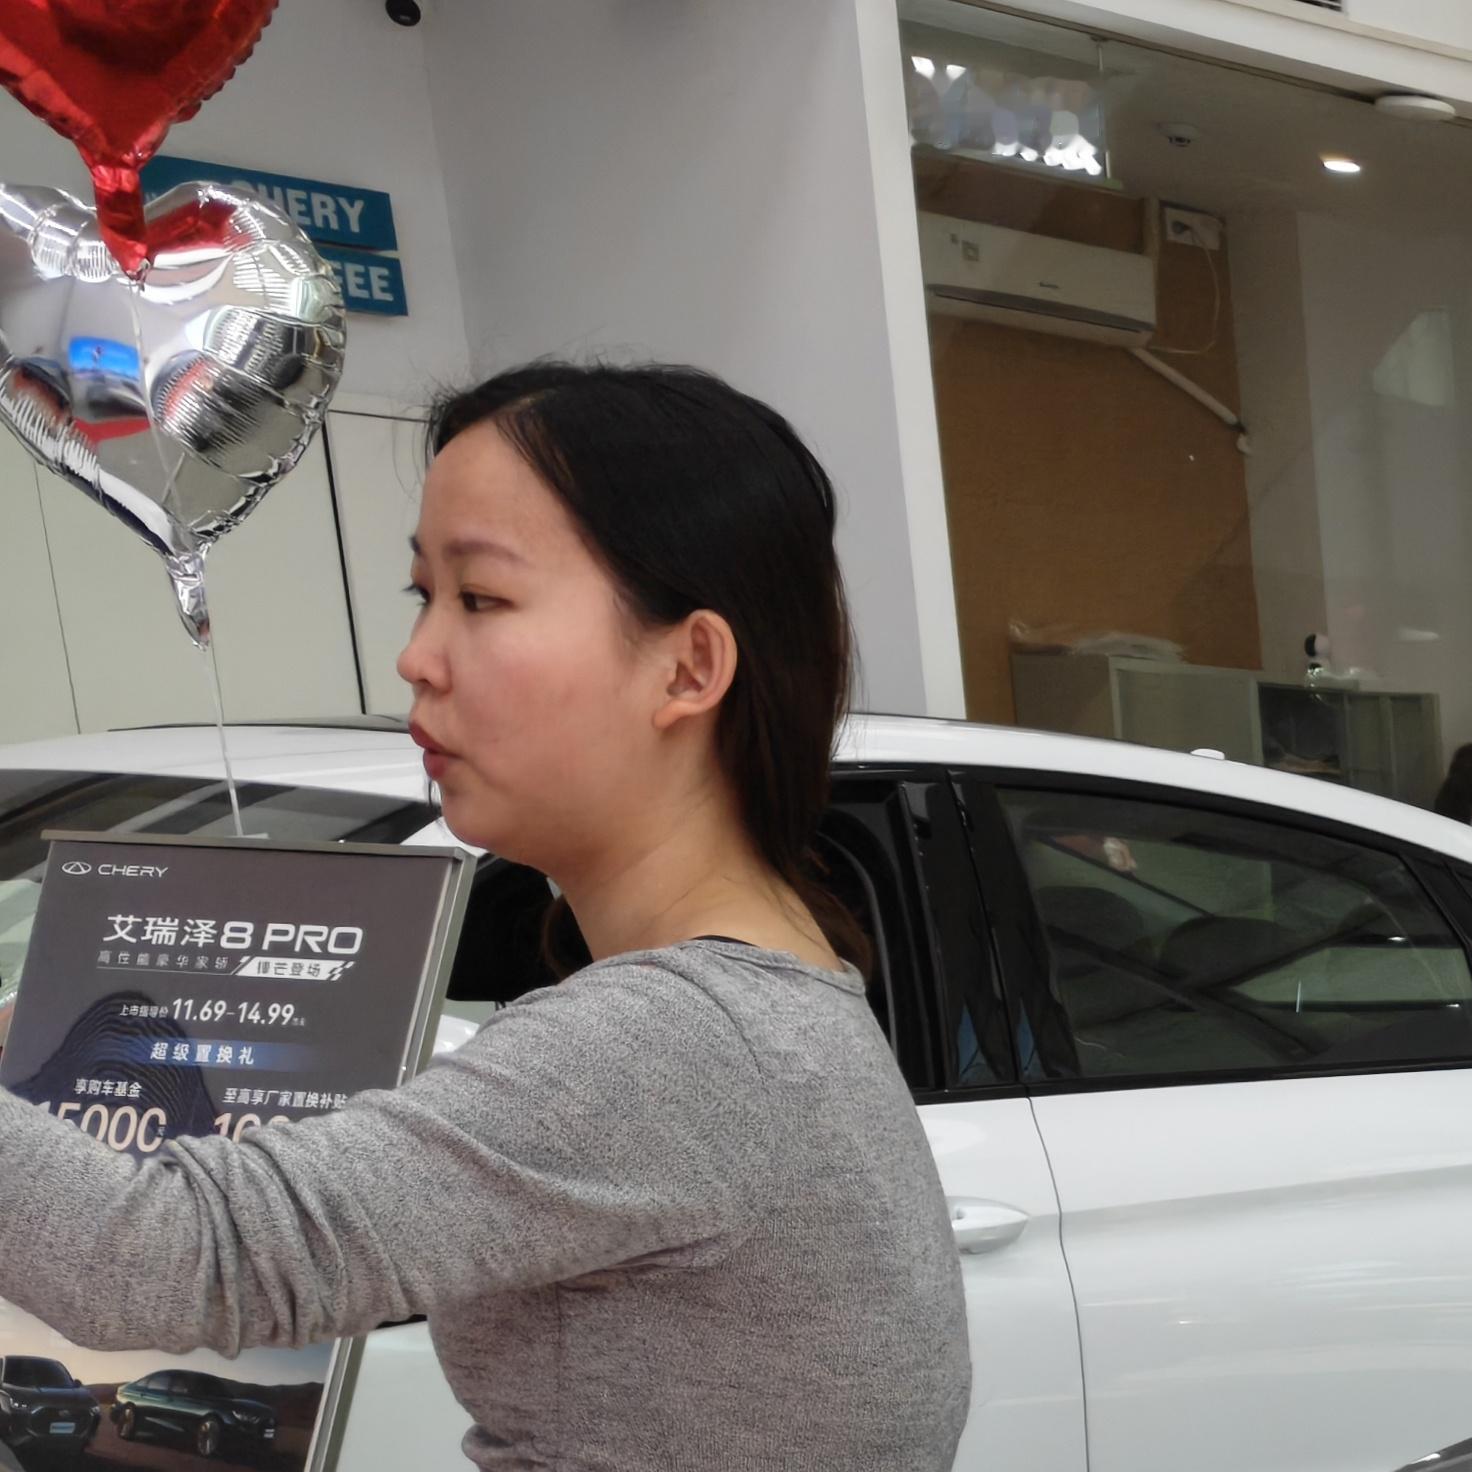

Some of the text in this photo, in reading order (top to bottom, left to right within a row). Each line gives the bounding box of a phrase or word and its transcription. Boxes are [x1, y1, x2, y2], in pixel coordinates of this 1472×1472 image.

[232, 180, 364, 233] ERY
[97, 863, 168, 878] CHERY
[262, 922, 363, 955] PRO
